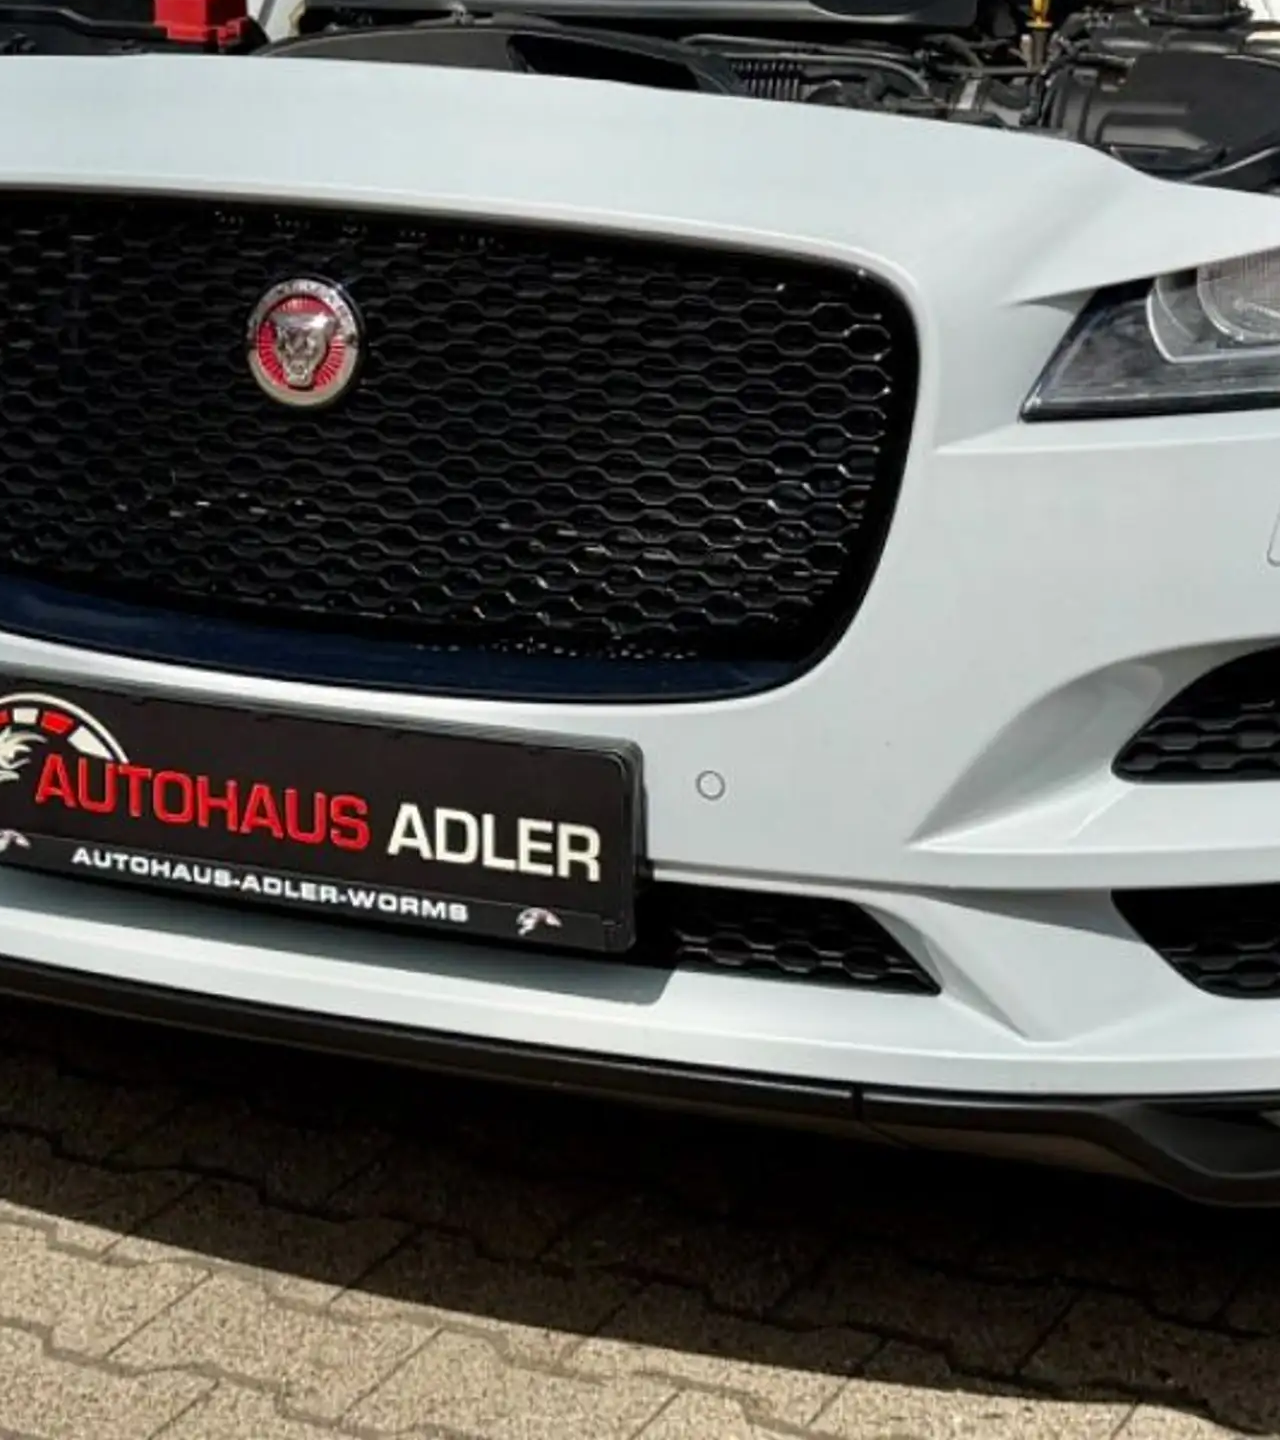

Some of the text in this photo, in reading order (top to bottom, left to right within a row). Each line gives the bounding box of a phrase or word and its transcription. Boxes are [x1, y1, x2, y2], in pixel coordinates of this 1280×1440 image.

[35, 752, 602, 883] AUTOHAUS ADLER
[71, 846, 470, 923] AUTOHAUS-ADLER-WORMS
